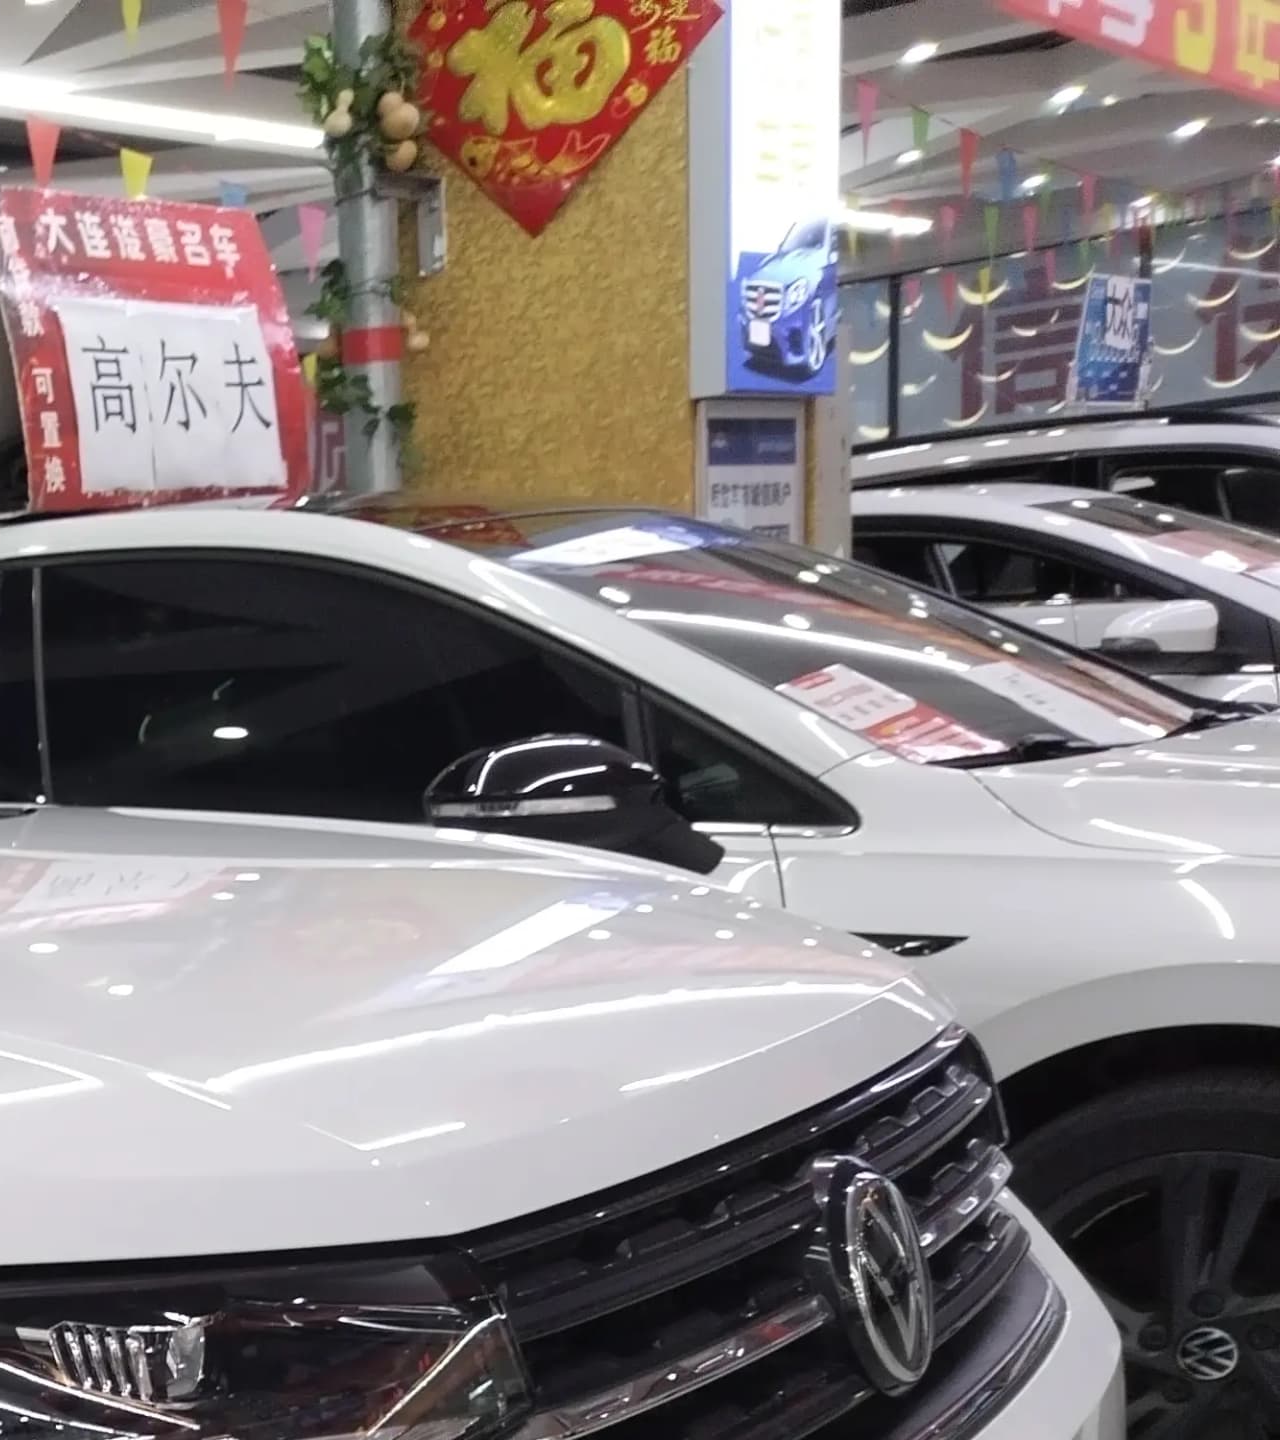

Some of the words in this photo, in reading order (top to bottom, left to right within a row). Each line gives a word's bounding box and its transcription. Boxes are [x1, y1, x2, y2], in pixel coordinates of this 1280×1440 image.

[447, 0, 631, 135] 福
[30, 366, 69, 495] 可置换
[81, 334, 272, 436] 高尔夫
